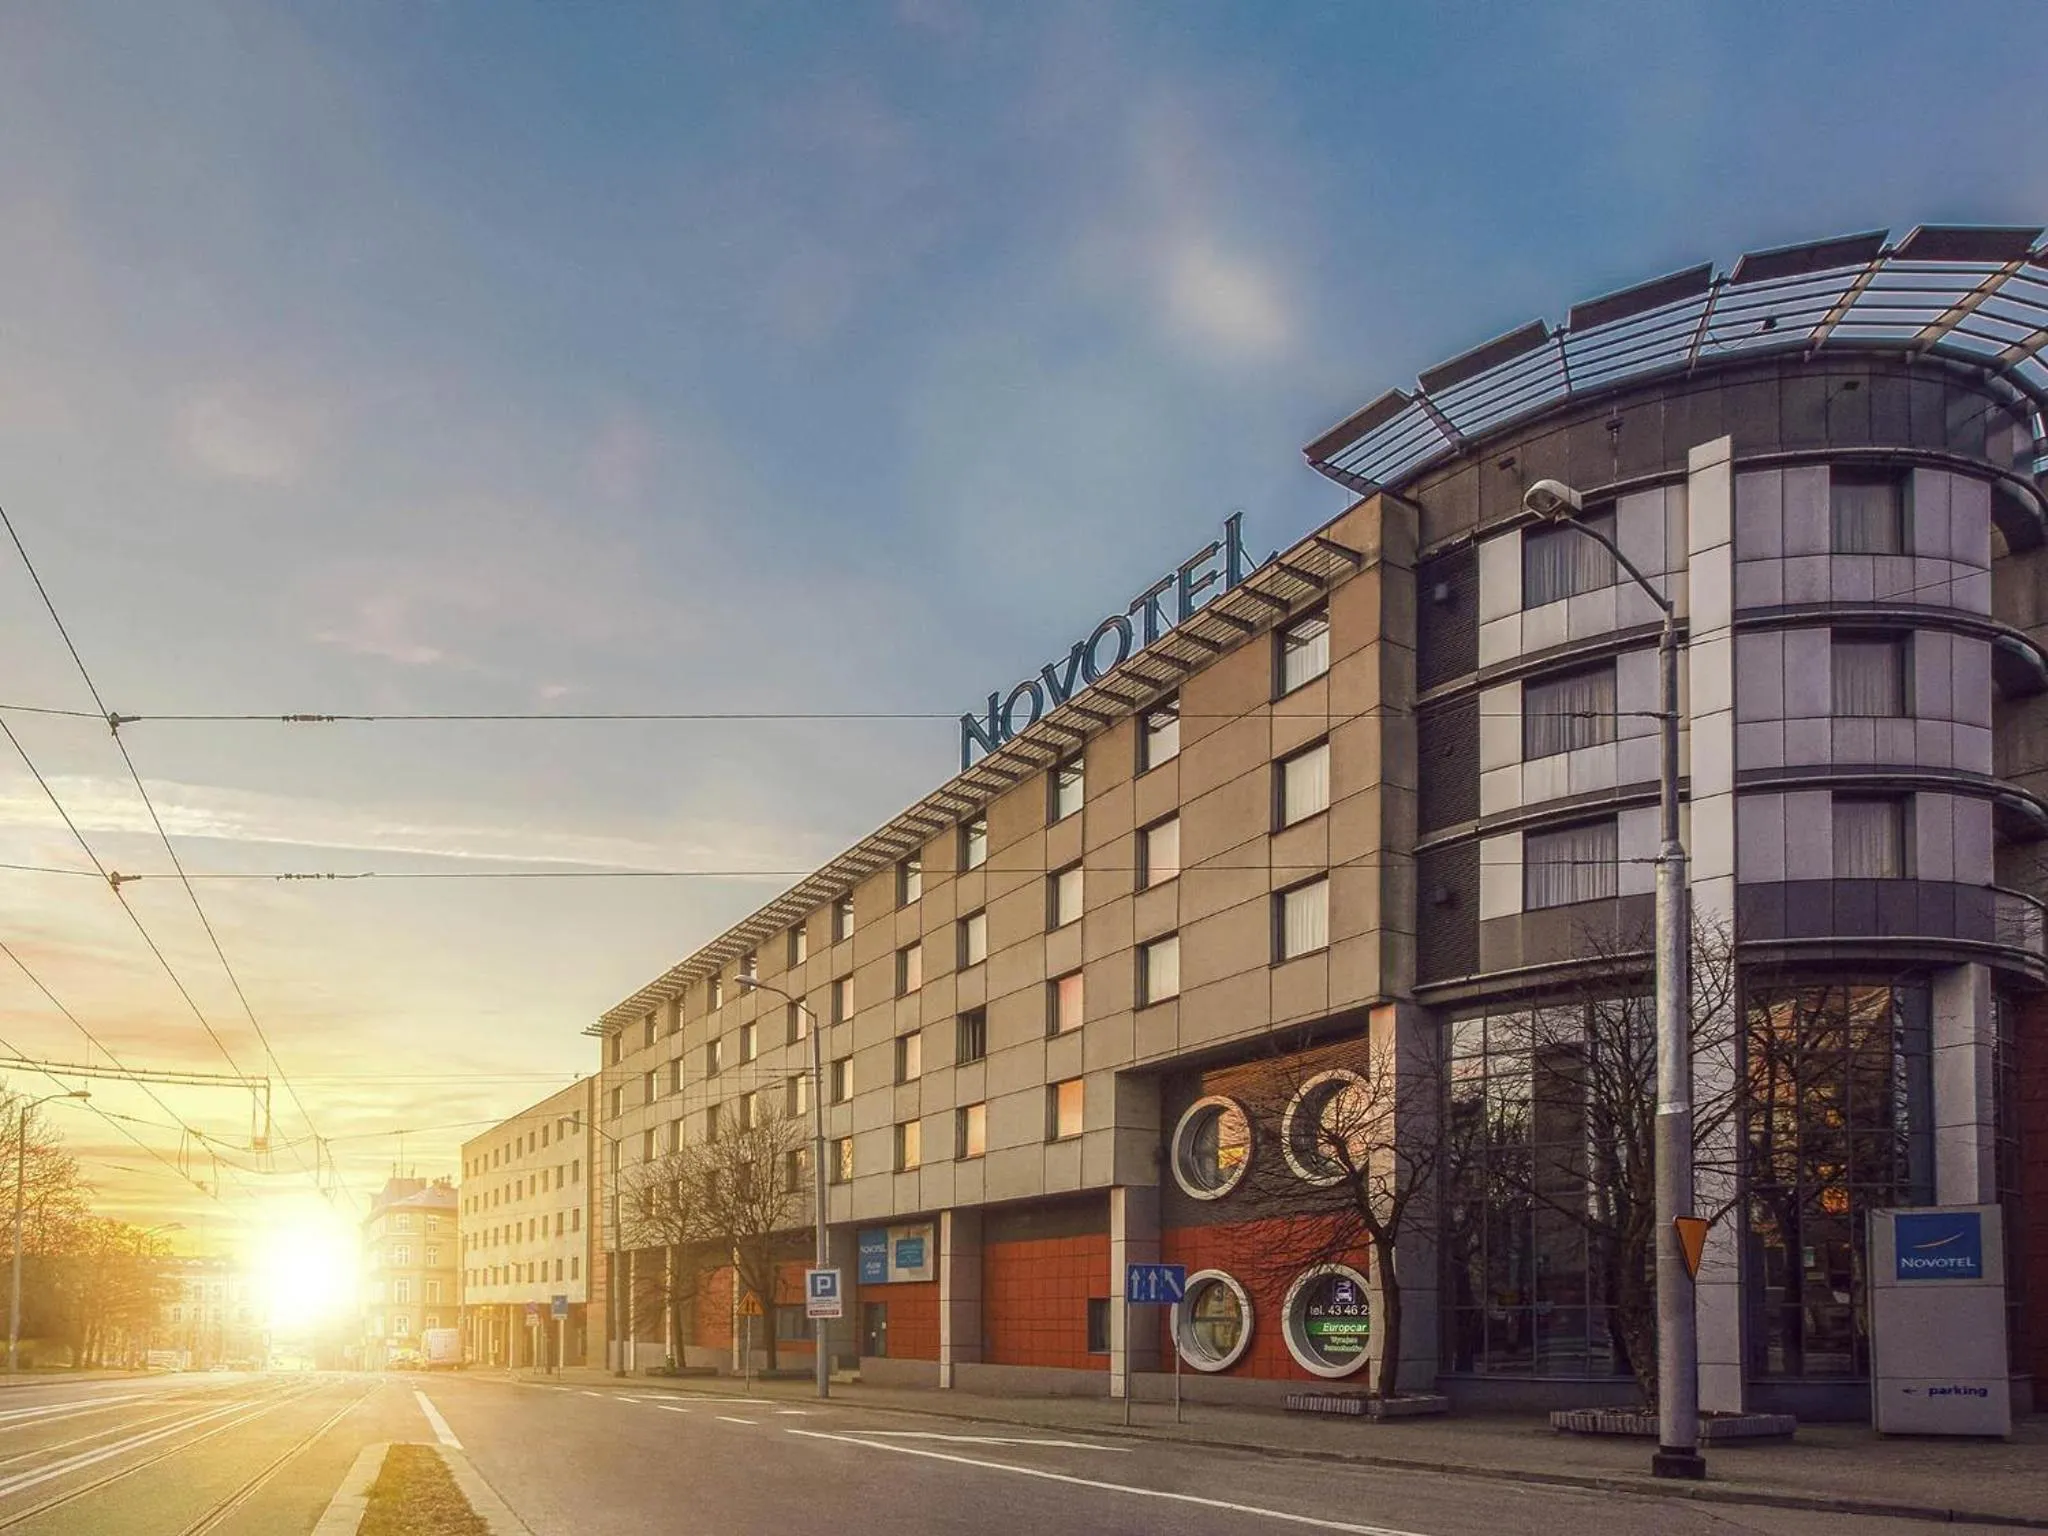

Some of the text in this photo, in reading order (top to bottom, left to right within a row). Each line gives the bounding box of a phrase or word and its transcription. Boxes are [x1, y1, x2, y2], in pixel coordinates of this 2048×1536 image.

[961, 511, 1278, 773] NOVOTEL
[1900, 1256, 1976, 1268] NOVOTEL
[816, 1275, 831, 1295] P
[1328, 1304, 1342, 1316] 43
[1344, 1304, 1358, 1316] 46
[1361, 1304, 1371, 1316] 2
[1322, 1322, 1368, 1334] Europcar
[1928, 1384, 1989, 1398] parking
